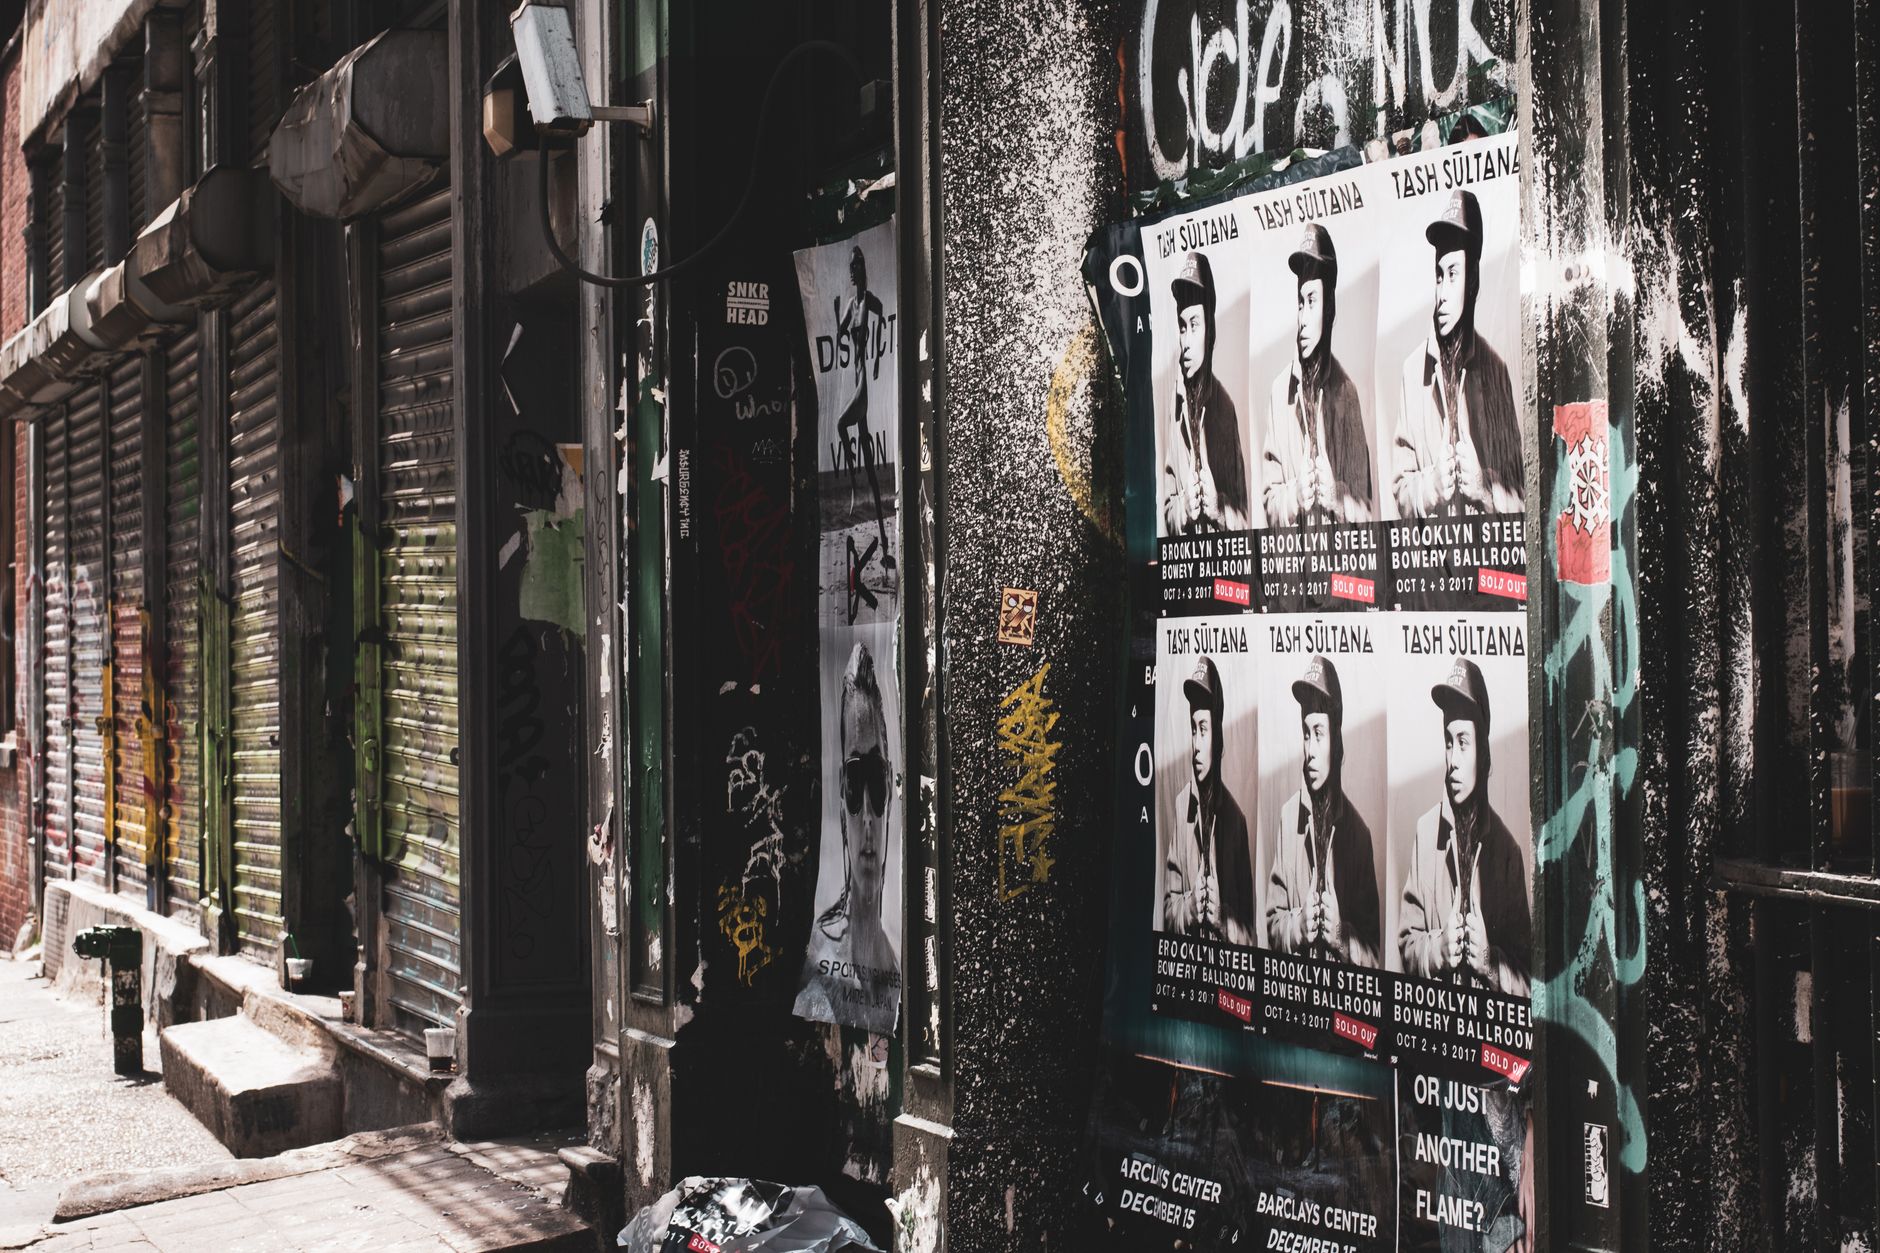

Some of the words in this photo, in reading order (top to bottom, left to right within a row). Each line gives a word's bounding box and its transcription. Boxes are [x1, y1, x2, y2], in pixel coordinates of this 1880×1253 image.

[1391, 163, 1439, 199] TASH
[1253, 198, 1294, 231] TASH
[1296, 181, 1364, 223] SŪLTANA
[1180, 212, 1239, 252] SŪLTANA
[728, 281, 769, 299] SNKR
[727, 308, 768, 325] HEAD
[1217, 537, 1252, 557] STEEL
[1261, 533, 1328, 554] BROOKLYN
[1335, 529, 1377, 551] STEEL
[1390, 523, 1473, 548] BROOKLYN
[1162, 563, 1194, 580] BOWERY
[1199, 559, 1252, 578] BALLROOM
[1261, 556, 1306, 575] BOWERY
[1312, 553, 1377, 573] BALLROOM
[1392, 549, 1447, 570] BOWERY
[1188, 587, 1192, 599] 3
[1195, 586, 1212, 599] 2017
[1215, 584, 1233, 597] SOLD
[1235, 587, 1249, 600] OUT
[1264, 583, 1279, 597] OCT
[1283, 583, 1288, 596] 2
[1307, 582, 1328, 596] 2017
[1333, 580, 1354, 594] SOLD
[1357, 584, 1374, 597] OUT
[1396, 578, 1416, 593] OCT
[1420, 578, 1426, 592] 2
[1439, 578, 1445, 592] 3
[1449, 577, 1474, 591] 2017
[1480, 575, 1504, 590] SOLD
[1507, 579, 1527, 595] OUT
[1167, 629, 1190, 655] TASH
[1194, 623, 1248, 654] SŪLTANA
[1269, 626, 1301, 653] TASH
[1305, 620, 1374, 653] SŪLTANA
[1402, 625, 1443, 655] TASH
[1448, 619, 1526, 656] SŪLTANA
[1219, 949, 1256, 972] STEEL
[1157, 959, 1197, 980] BOWERY
[1202, 969, 1255, 992] BALLROOM
[1264, 957, 1331, 987] BROOKLYN
[1337, 970, 1382, 997] STEEL
[1190, 989, 1195, 1001] 3
[1198, 990, 1215, 1005] 207
[1236, 1001, 1251, 1017] OUT
[1263, 979, 1307, 1003] BOWERY
[1313, 989, 1382, 1018] BALLROOM
[1394, 981, 1477, 1016] BROOKLYN
[1486, 999, 1533, 1028] STEEL
[1265, 1005, 1284, 1021] OCT
[1286, 1010, 1291, 1022] 2
[1302, 1013, 1307, 1026] 3
[1309, 1015, 1330, 1030] 2017
[1394, 1005, 1450, 1032] BOWERY
[1457, 1018, 1533, 1050] BALLROOM
[1335, 1019, 1357, 1036] SOLD
[1361, 1028, 1377, 1044] OUT
[1397, 1032, 1417, 1049] OCT
[1421, 1038, 1427, 1051] 2
[1442, 1043, 1447, 1056] 3
[1452, 1045, 1476, 1062] 2017
[1483, 1050, 1508, 1070] SOLD
[1414, 1074, 1440, 1106] OR
[1444, 1080, 1490, 1115] JUST
[1415, 1132, 1500, 1176] ANOTHER
[1120, 1157, 1170, 1190] ARCLYS
[1172, 1172, 1222, 1204] CENTER
[1182, 1208, 1196, 1230] 15
[1256, 1191, 1320, 1226] BARCLAYS
[1324, 1206, 1377, 1238] CENTER
[1416, 1189, 1485, 1232] FLAME?
